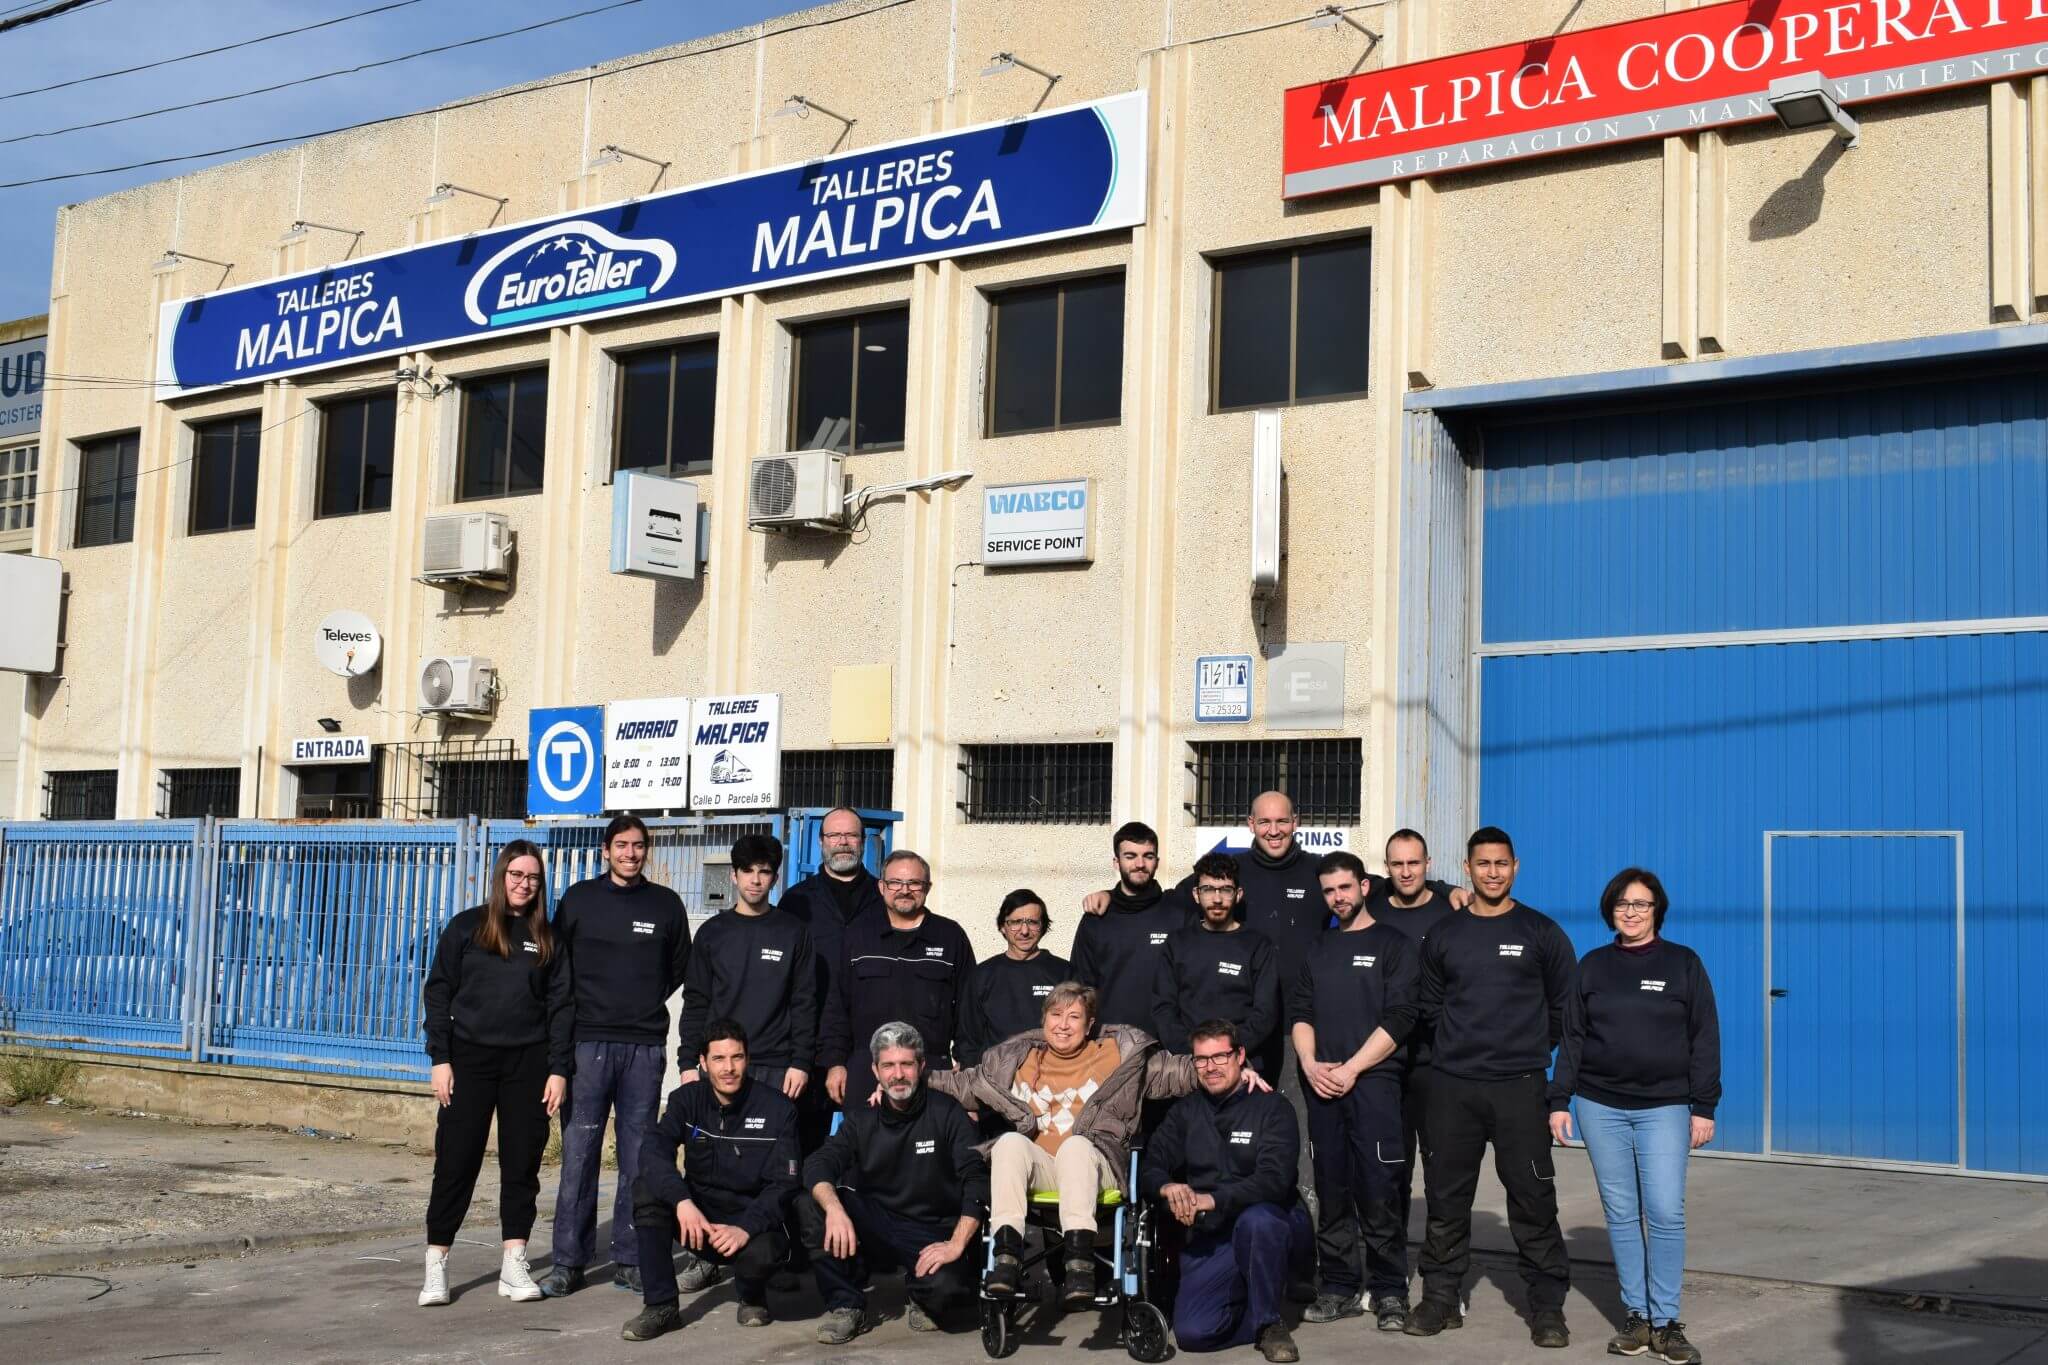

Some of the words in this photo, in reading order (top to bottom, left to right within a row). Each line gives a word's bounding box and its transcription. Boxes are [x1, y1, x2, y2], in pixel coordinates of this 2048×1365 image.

[1319, 55, 1597, 148] MALPICA
[1393, 121, 1620, 176] REPARACIÓN
[1647, 114, 1662, 131] Y
[1688, 48, 2048, 125] MANNIMIENTO
[810, 150, 954, 205] TALLERES
[752, 179, 1002, 272] MALPICA
[497, 252, 643, 310] EuroTaller
[277, 272, 375, 316] TALLERES
[235, 296, 403, 370] MALPICA
[989, 489, 1085, 514] WABCO
[987, 539, 1042, 552] SERVICE
[1045, 536, 1083, 549] POINT
[323, 628, 371, 642] Televes
[709, 700, 759, 715] TALLERES
[616, 719, 678, 740] HORARIO
[695, 721, 769, 745] MALPICA
[296, 739, 364, 758] ENTRADA
[623, 758, 640, 768] 8:00
[660, 757, 680, 767] 13:00
[661, 777, 682, 787] 19:00
[693, 795, 712, 805] Calle
[715, 794, 721, 804] D
[728, 793, 758, 804] Parcela
[761, 793, 771, 803] 96
[1294, 831, 1343, 846] CINAS
